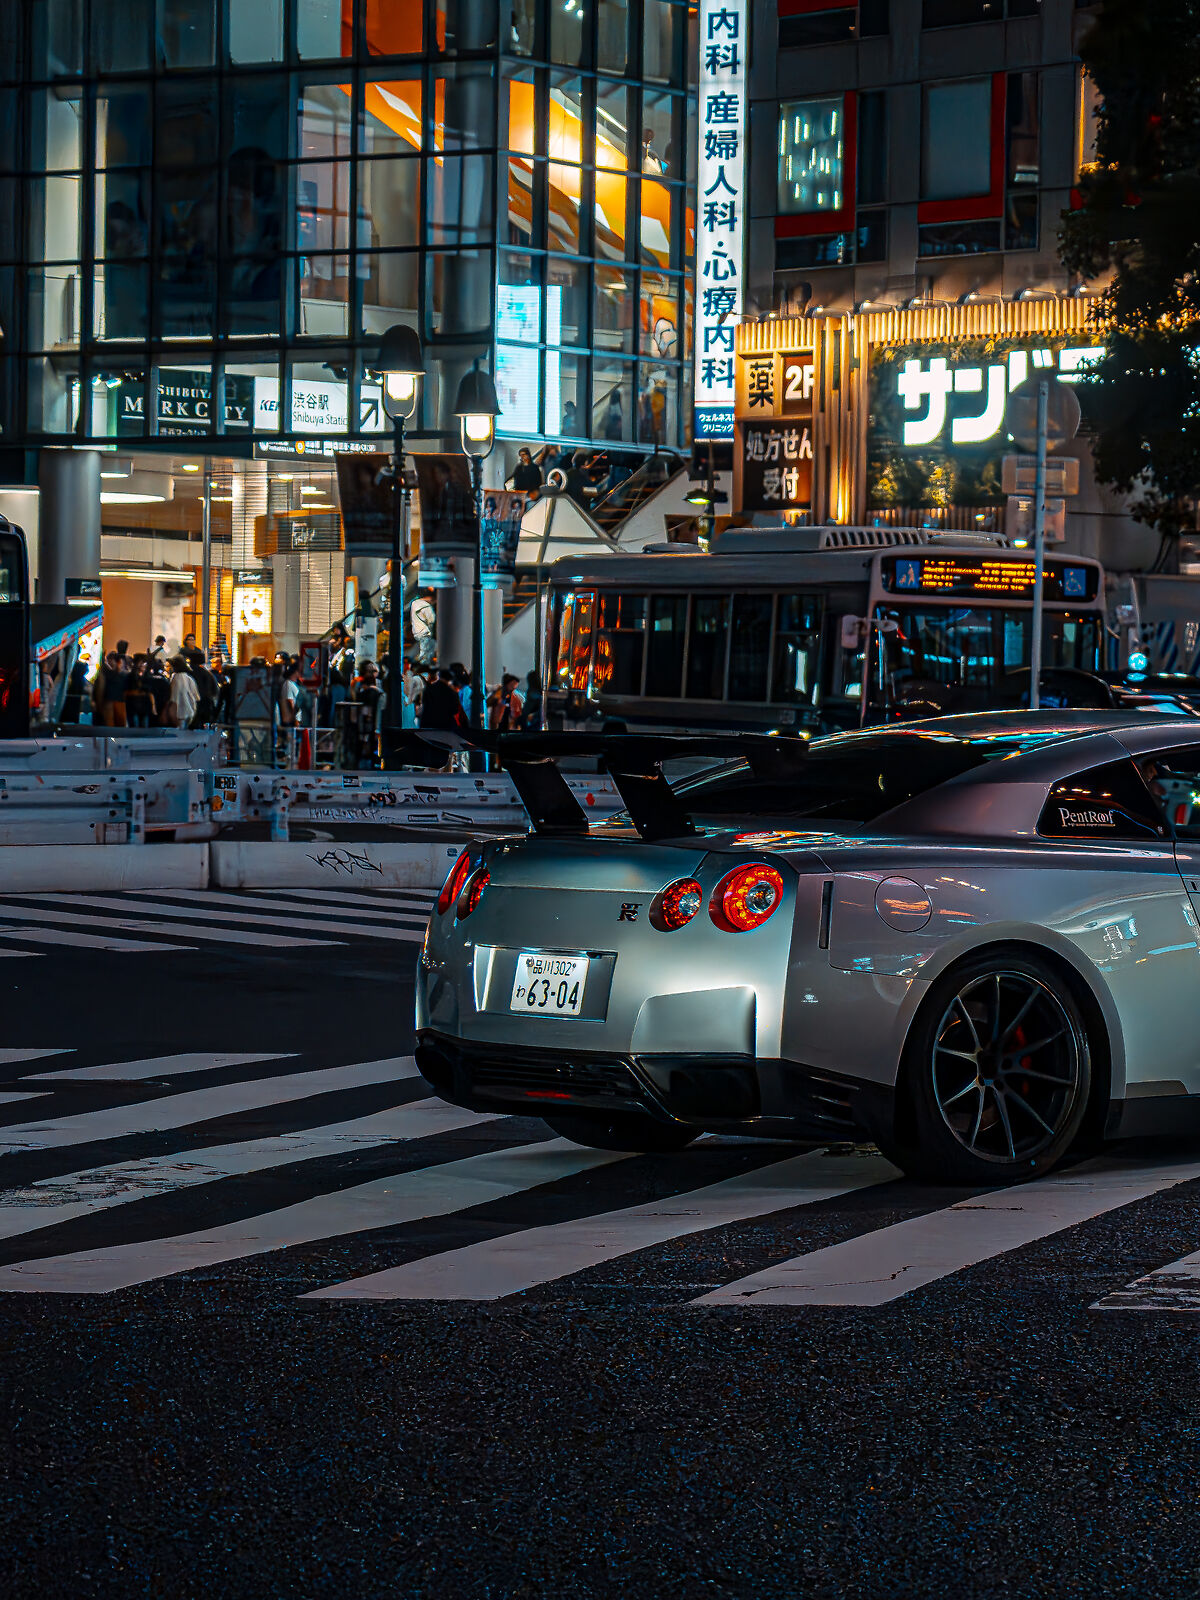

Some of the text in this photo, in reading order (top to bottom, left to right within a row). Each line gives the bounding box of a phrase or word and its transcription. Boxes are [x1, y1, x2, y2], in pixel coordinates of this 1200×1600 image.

[706, 8, 740, 75] 内科
[157, 384, 211, 399] SHIBUY
[748, 361, 774, 408] 薬
[785, 365, 815, 400] 2F
[124, 396, 247, 420] MRK CTY
[294, 391, 329, 410] 渋谷駅
[293, 411, 348, 427] Shibuya Statio
[699, 413, 735, 423] ウェルネス
[703, 423, 734, 432] クリニック
[746, 427, 813, 461] 処方せん
[763, 467, 800, 500] 受付
[516, 978, 580, 1010] わ 63-04
